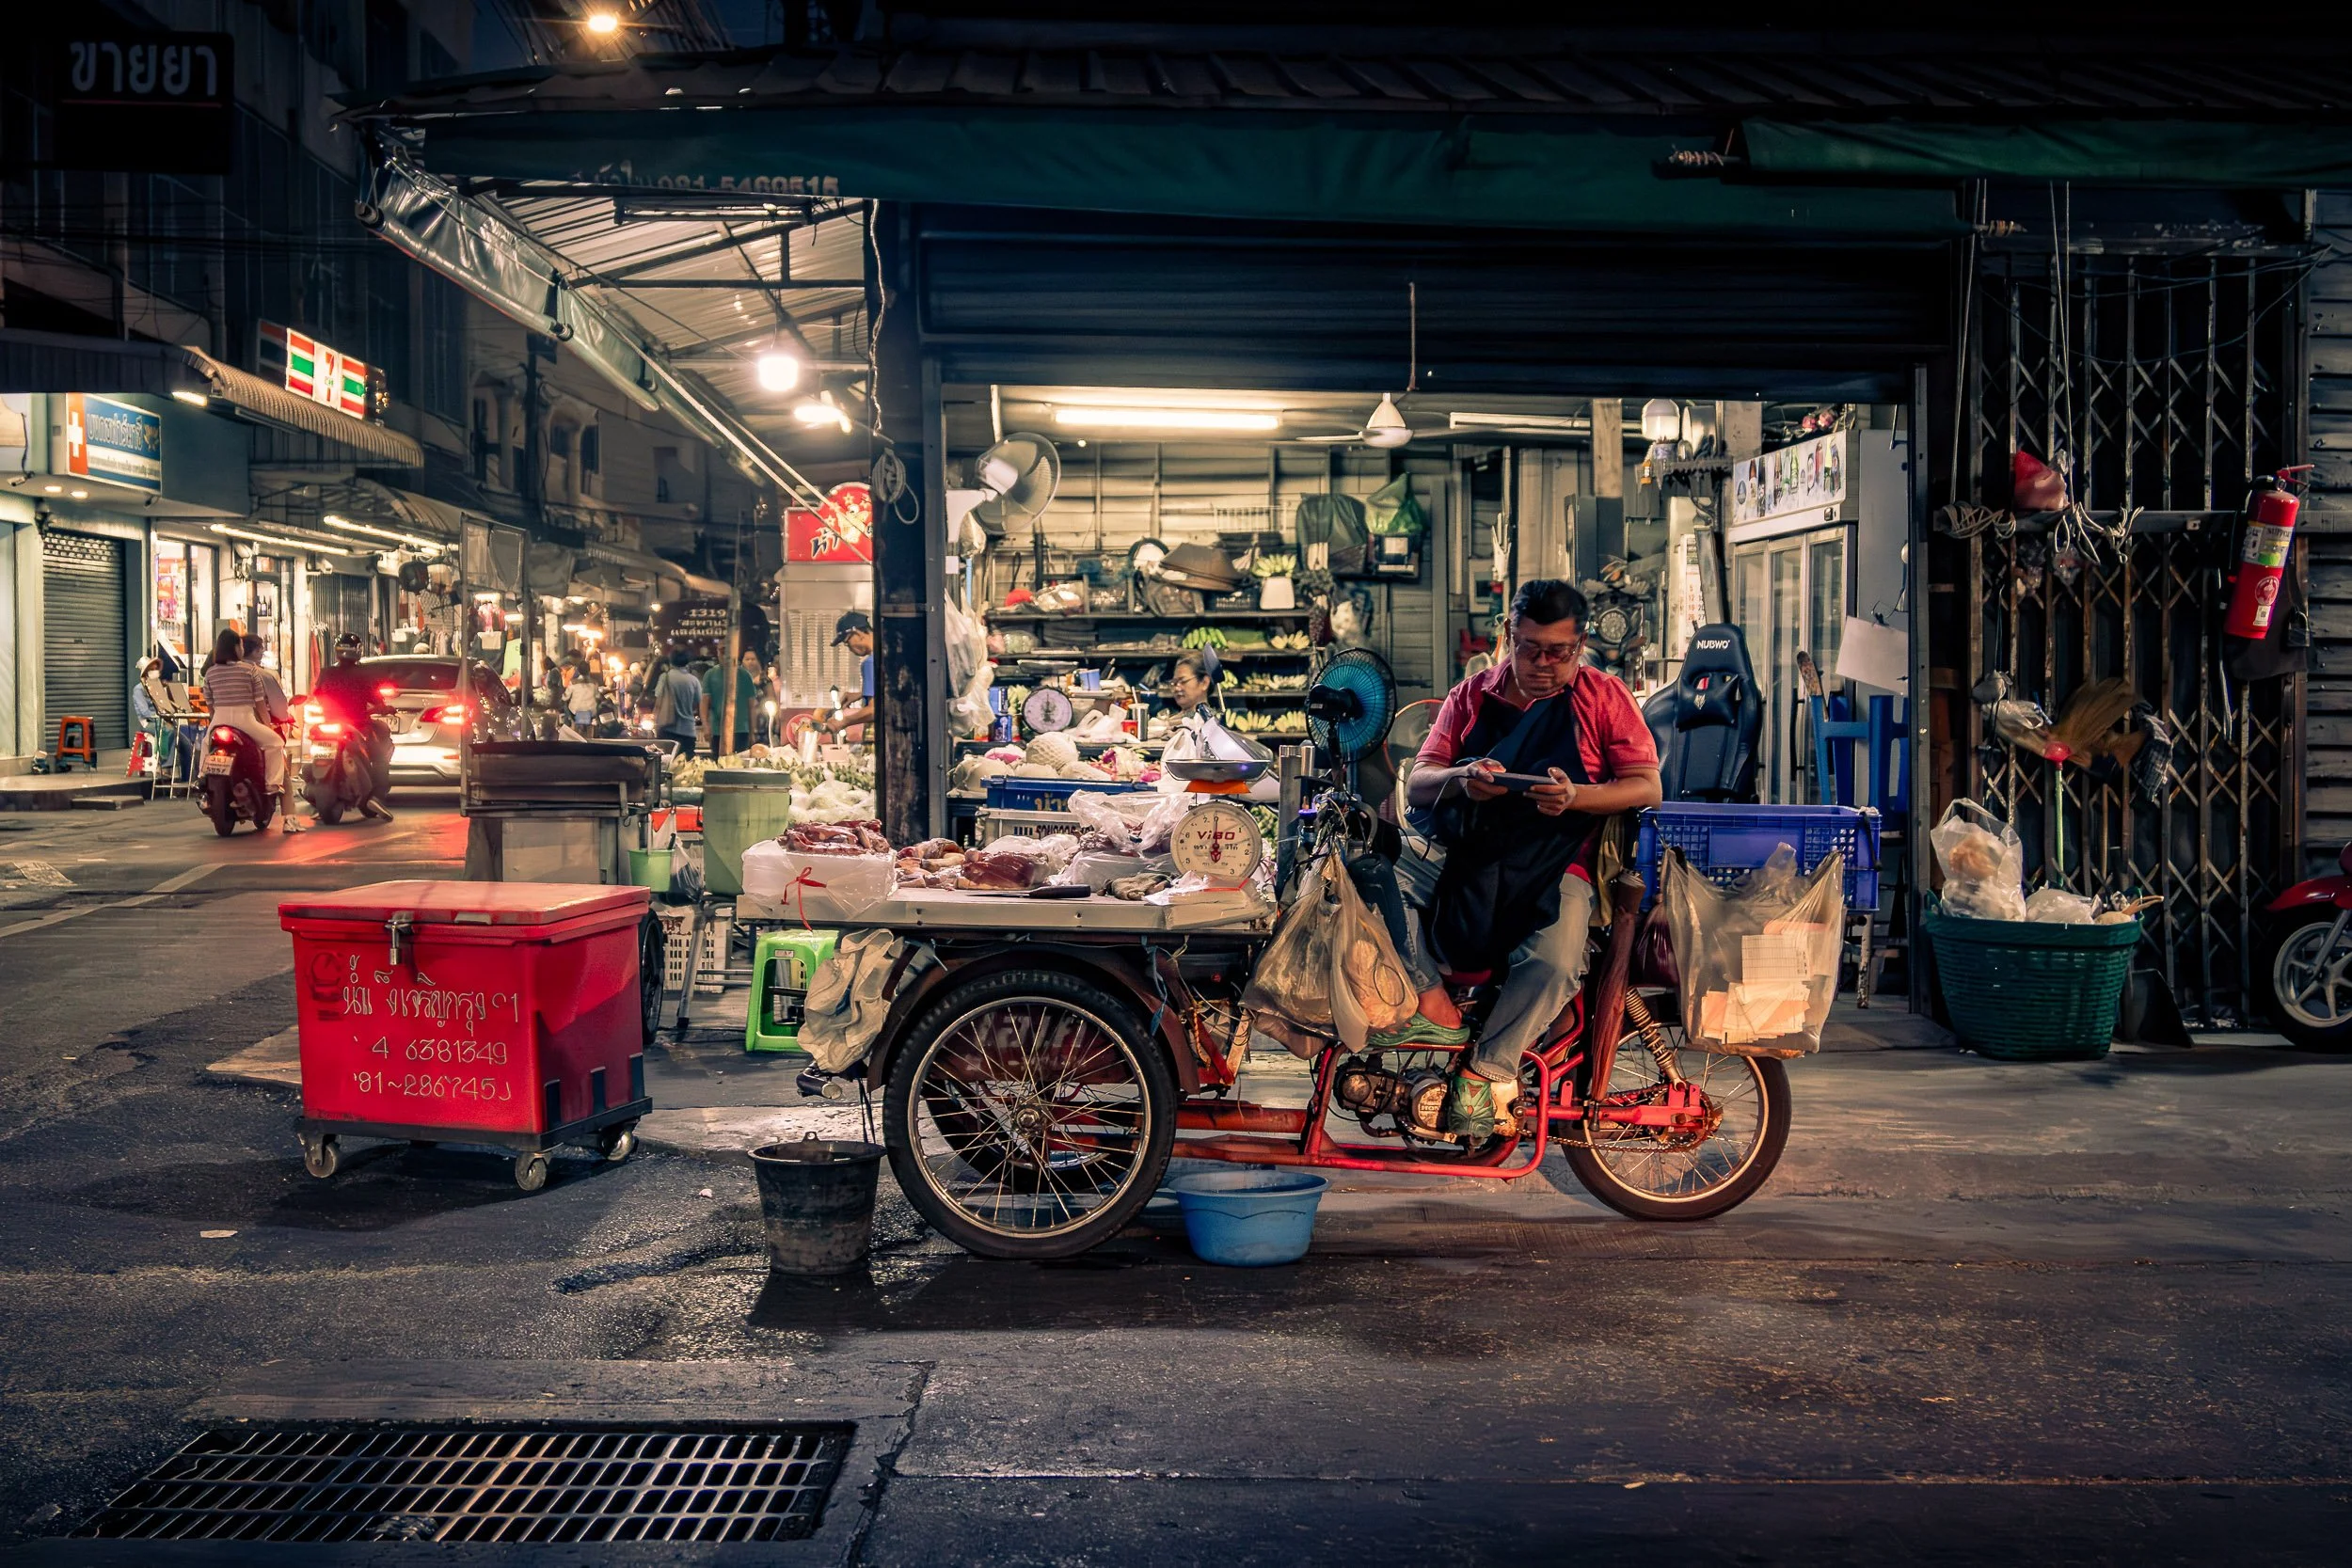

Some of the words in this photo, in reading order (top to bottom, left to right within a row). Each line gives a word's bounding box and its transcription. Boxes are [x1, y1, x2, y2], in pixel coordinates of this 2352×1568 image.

[69, 40, 218, 97] ขายยา
[1696, 640, 1729, 650] NUBWO
[405, 1038, 508, 1065] 6381349
